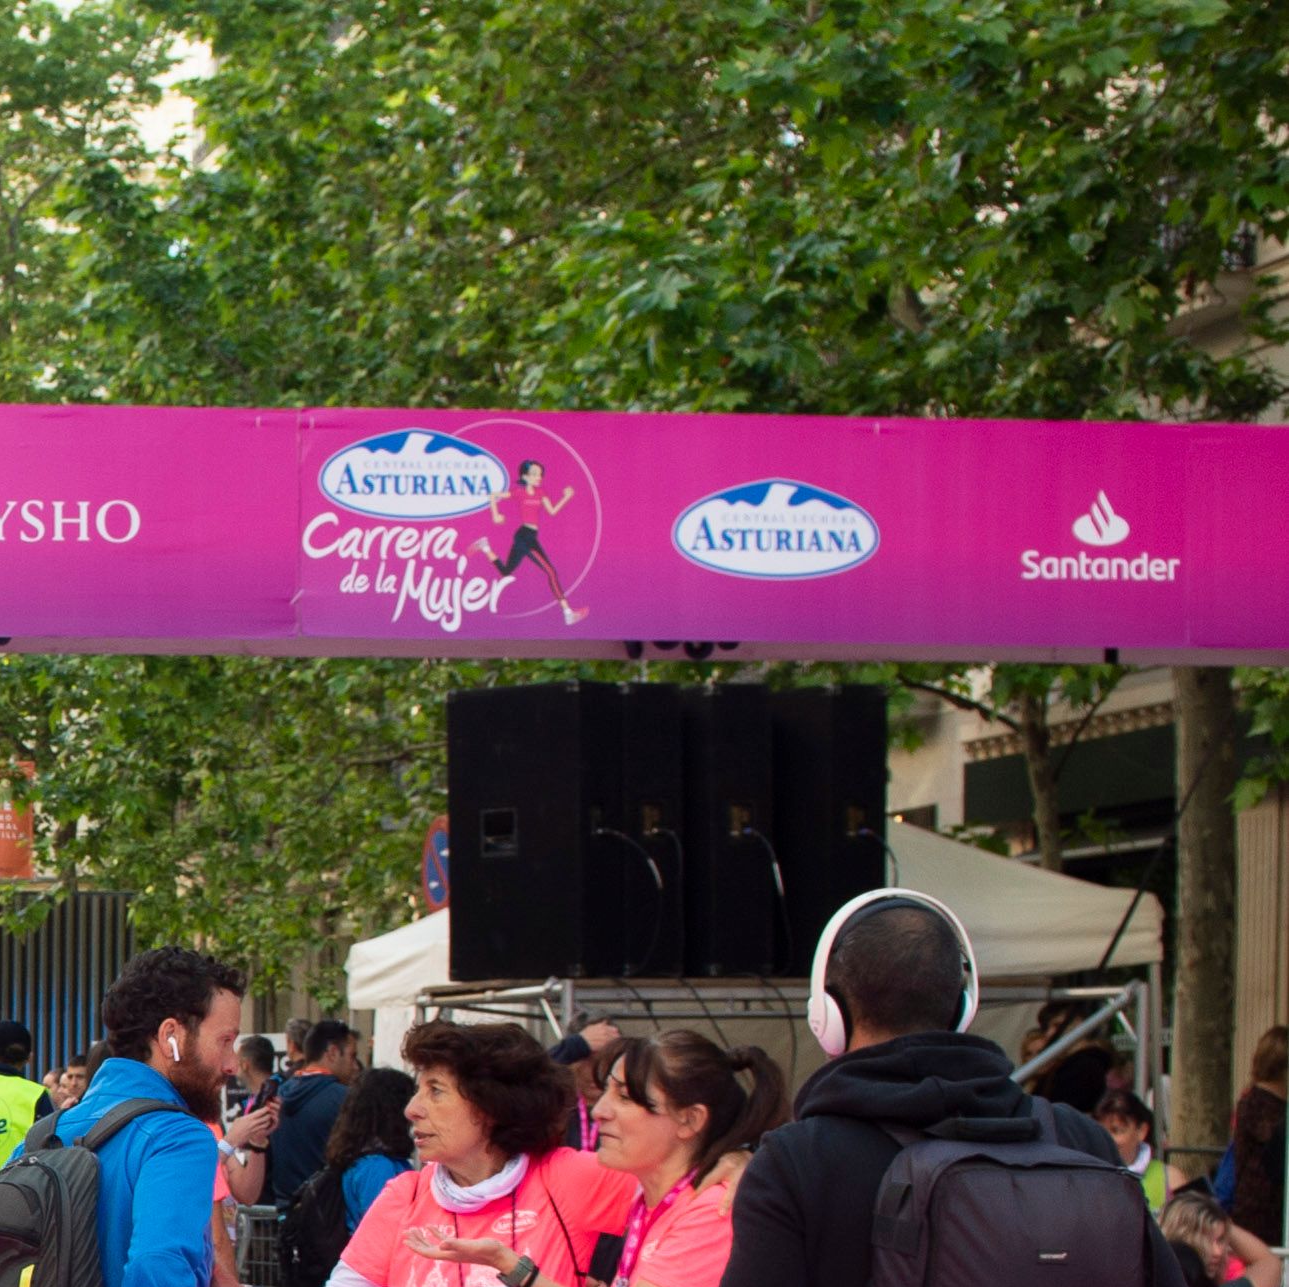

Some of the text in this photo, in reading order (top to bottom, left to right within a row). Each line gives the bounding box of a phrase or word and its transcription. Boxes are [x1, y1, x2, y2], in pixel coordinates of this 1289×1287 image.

[335, 463, 492, 496] ASTURIANA
[302, 512, 458, 560] Carrera
[691, 516, 863, 553] ASTURIANA
[1021, 549, 1180, 583] Santander
[339, 555, 517, 633] de la Mujer
